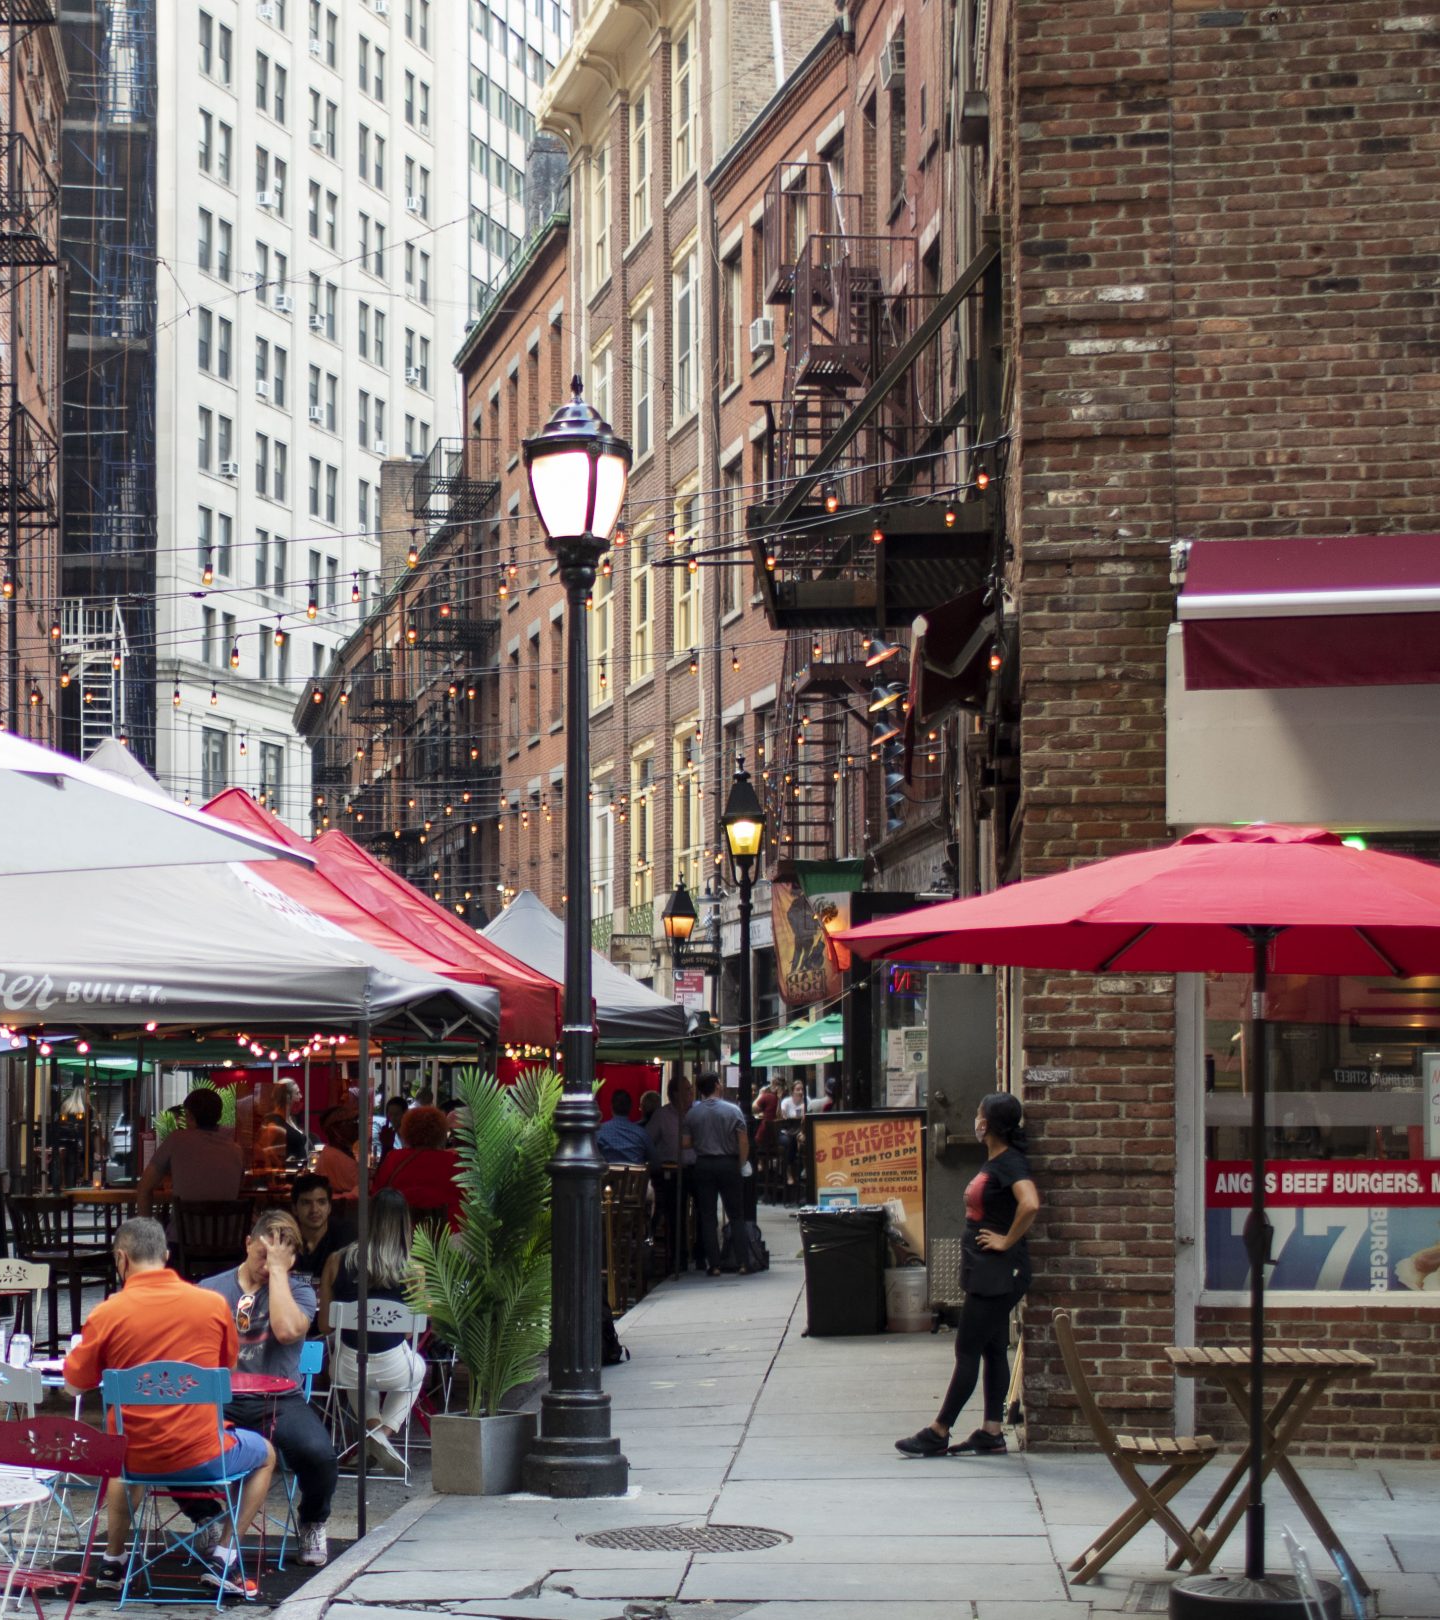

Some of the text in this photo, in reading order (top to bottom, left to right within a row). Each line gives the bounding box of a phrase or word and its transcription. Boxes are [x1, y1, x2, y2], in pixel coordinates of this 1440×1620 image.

[65, 981, 163, 1004] BULLET
[831, 1119, 916, 1145] TAKEOUT
[832, 1131, 917, 1160] DELIVERY
[850, 1157, 860, 1166] 12
[862, 1154, 876, 1164] PM
[878, 1151, 892, 1160] TO
[902, 1146, 917, 1156] PM
[1215, 1173, 1277, 1194] ANGS
[1281, 1173, 1328, 1193] BEEF
[1332, 1173, 1424, 1194] BURGERS.
[1370, 1207, 1389, 1292] BURGER
